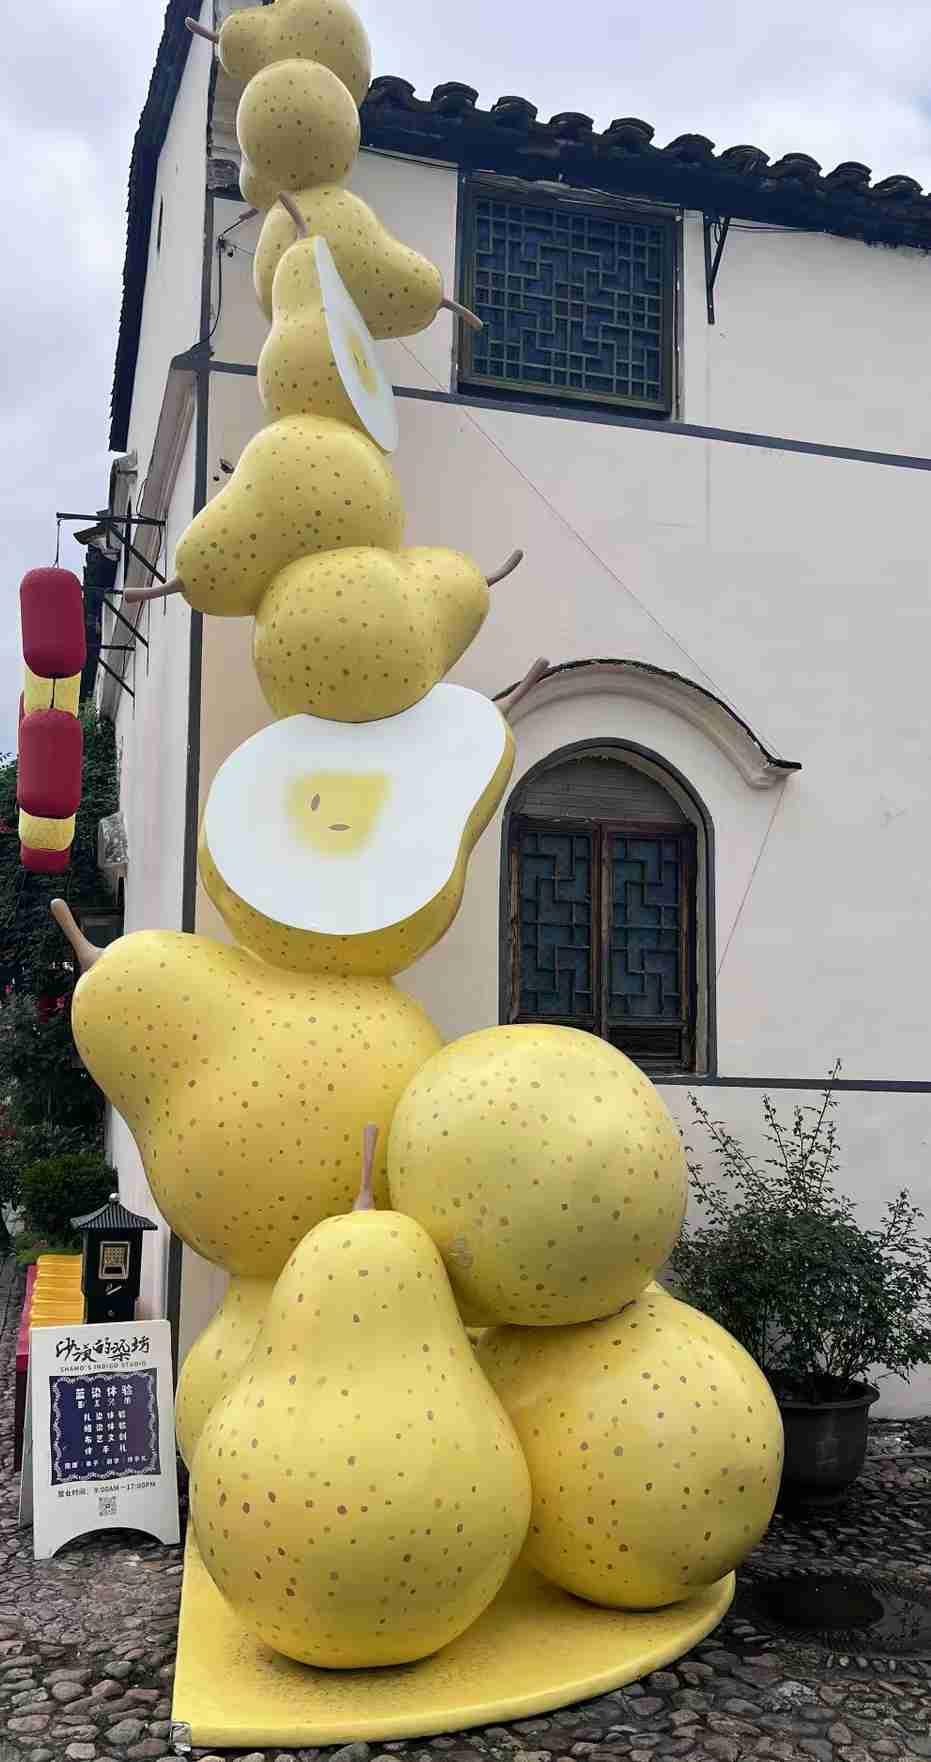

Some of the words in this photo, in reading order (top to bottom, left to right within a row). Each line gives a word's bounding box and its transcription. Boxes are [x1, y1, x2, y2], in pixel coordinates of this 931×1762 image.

[93, 1362, 119, 1371] INDIGO
[121, 1359, 147, 1368] STUDIO
[75, 1384, 134, 1401] 蓝染体验
[83, 1432, 128, 1444] 布艺文创
